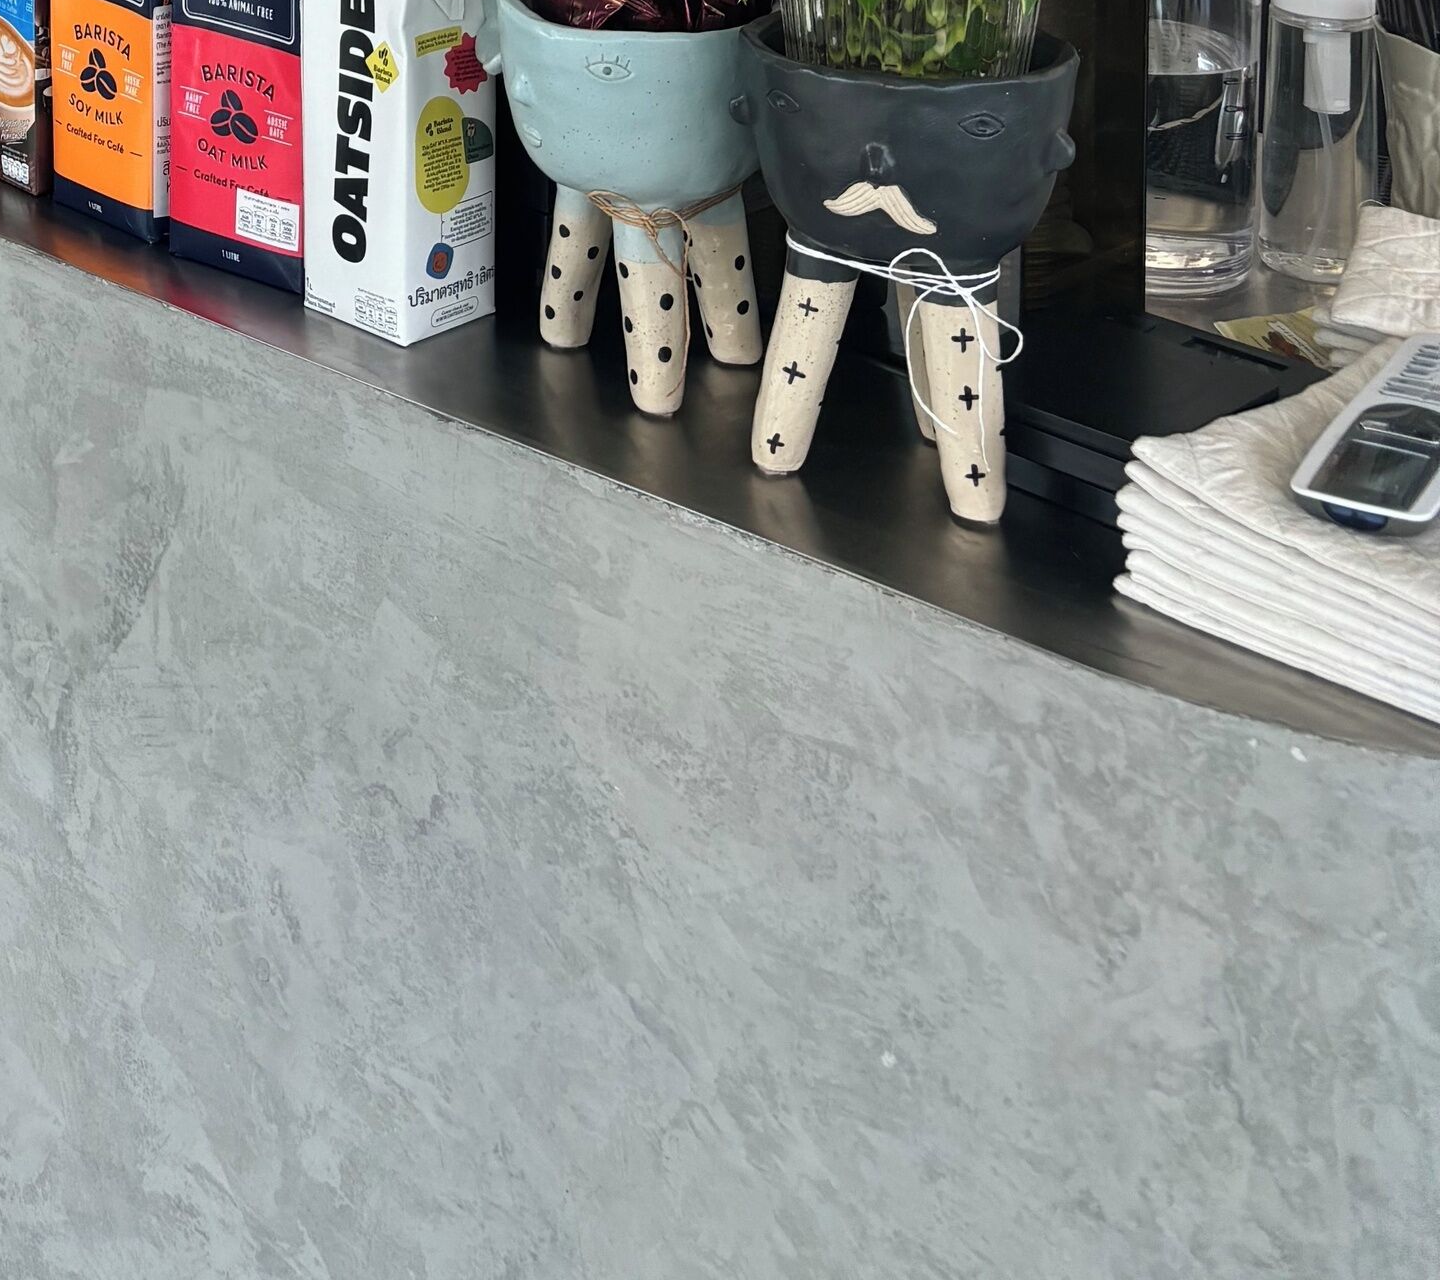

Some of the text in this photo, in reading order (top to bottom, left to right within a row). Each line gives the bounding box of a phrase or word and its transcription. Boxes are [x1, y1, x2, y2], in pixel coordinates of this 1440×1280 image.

[256, 3, 274, 21] FREE
[74, 23, 131, 61] BARISTA
[61, 58, 72, 72] FREE
[373, 64, 393, 78] Barista
[124, 72, 141, 87] AUSSIE
[201, 64, 276, 103] BARISTA
[375, 73, 391, 85] Blend
[184, 90, 203, 106] DAIRY
[68, 92, 124, 125] SOY MILK
[185, 99, 201, 115] FREE
[266, 114, 288, 131] AUSSIE
[66, 122, 125, 154] Crafted For Café
[268, 124, 284, 140] OATS
[197, 138, 268, 170] OAT MILK
[193, 168, 228, 190] Crafted
[226, 251, 241, 262] LITRE
[408, 271, 474, 309] ปริมาตรสุทธิ
